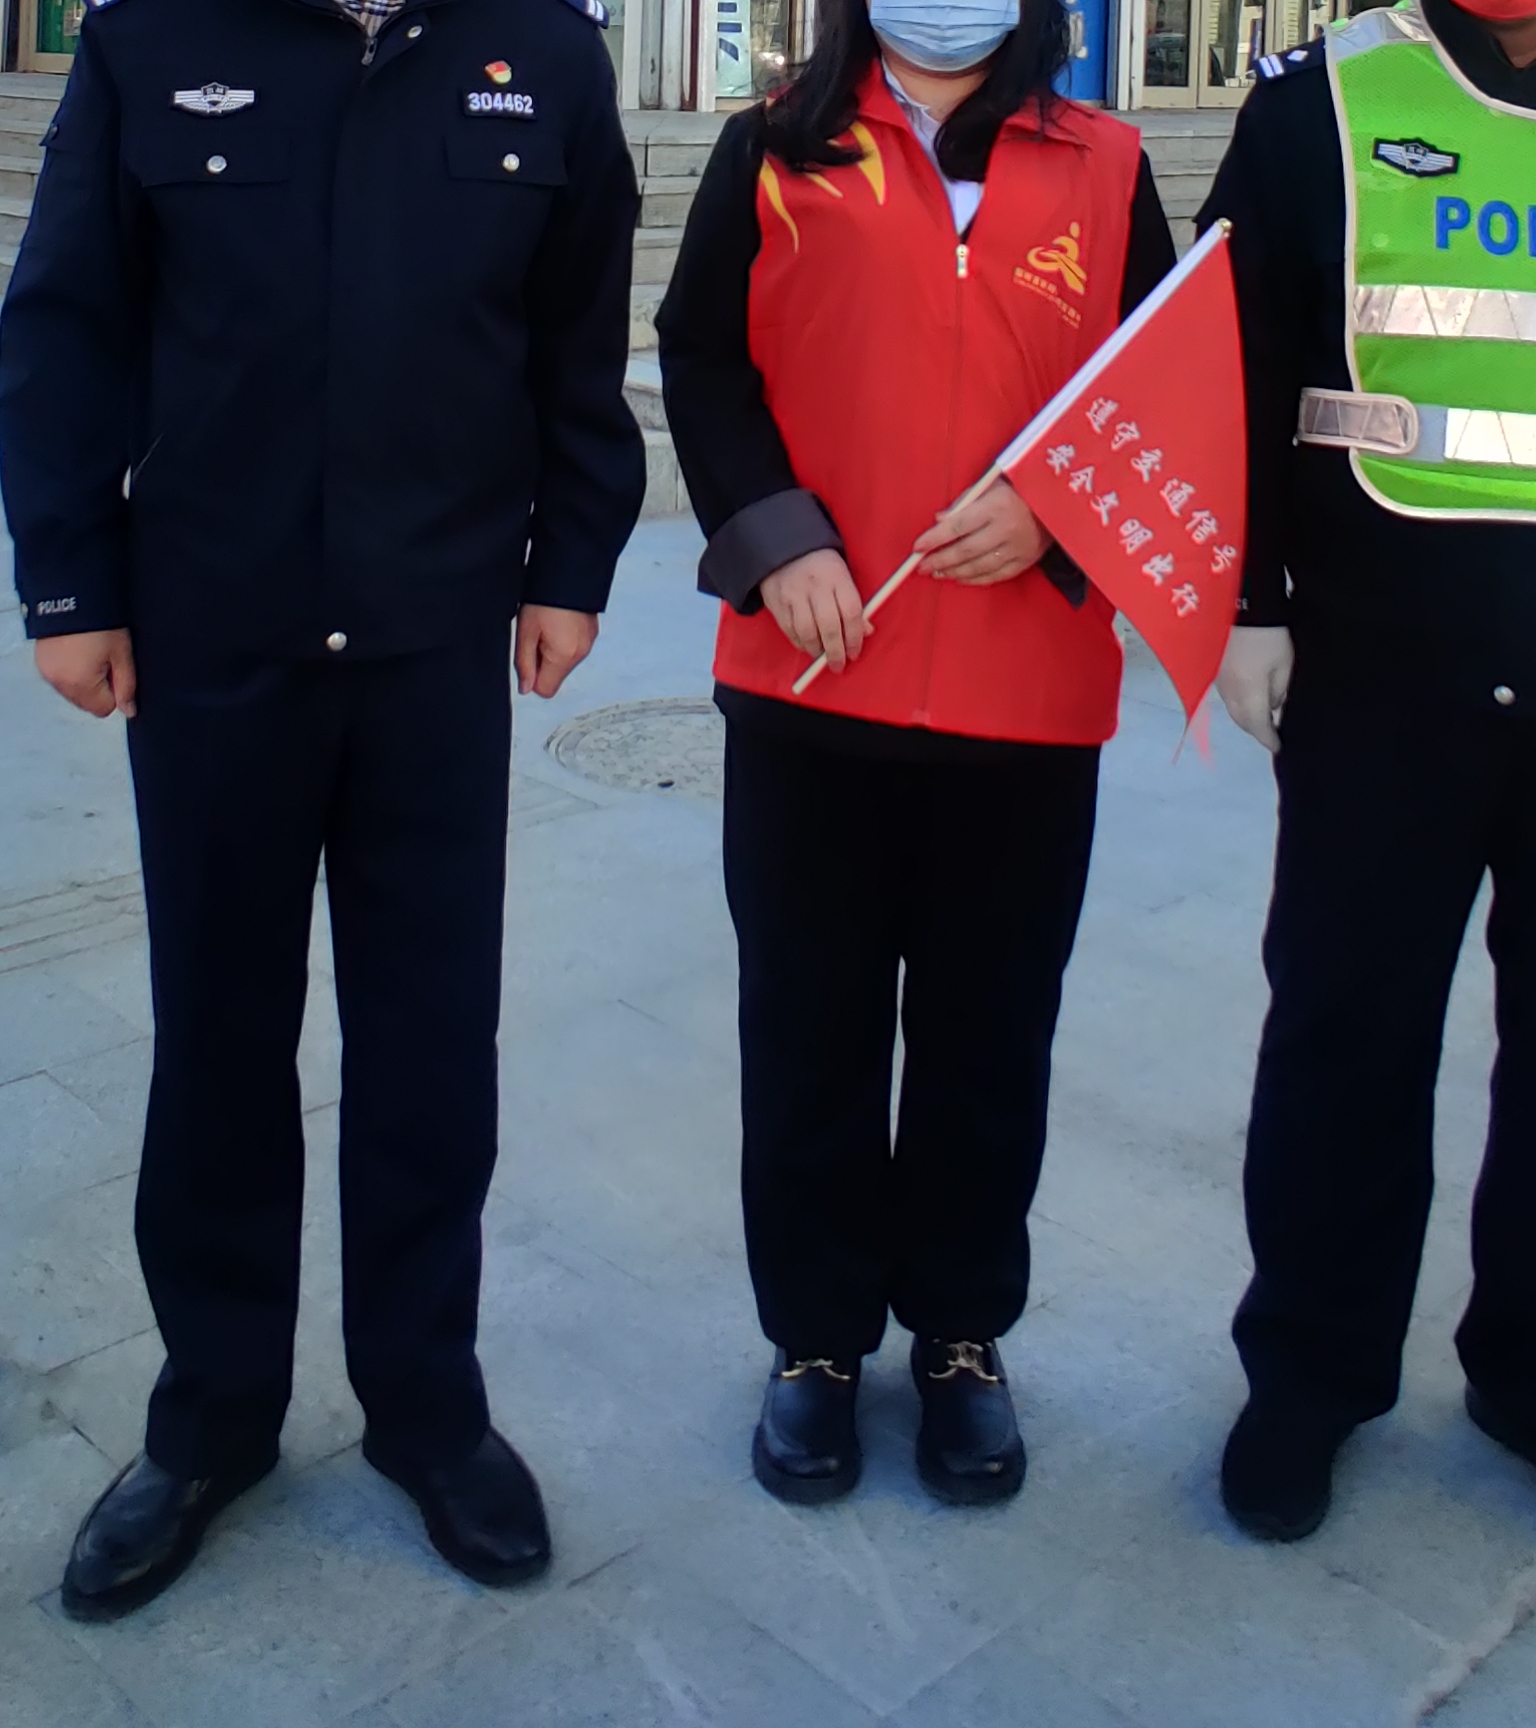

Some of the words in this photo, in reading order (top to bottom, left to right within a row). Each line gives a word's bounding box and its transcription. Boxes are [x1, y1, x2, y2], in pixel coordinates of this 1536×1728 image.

[467, 92, 535, 115] 304462
[1045, 443, 1200, 618] 安全文明出行
[1085, 396, 1238, 574] 遵守交通信号
[37, 596, 77, 617] POLICE
